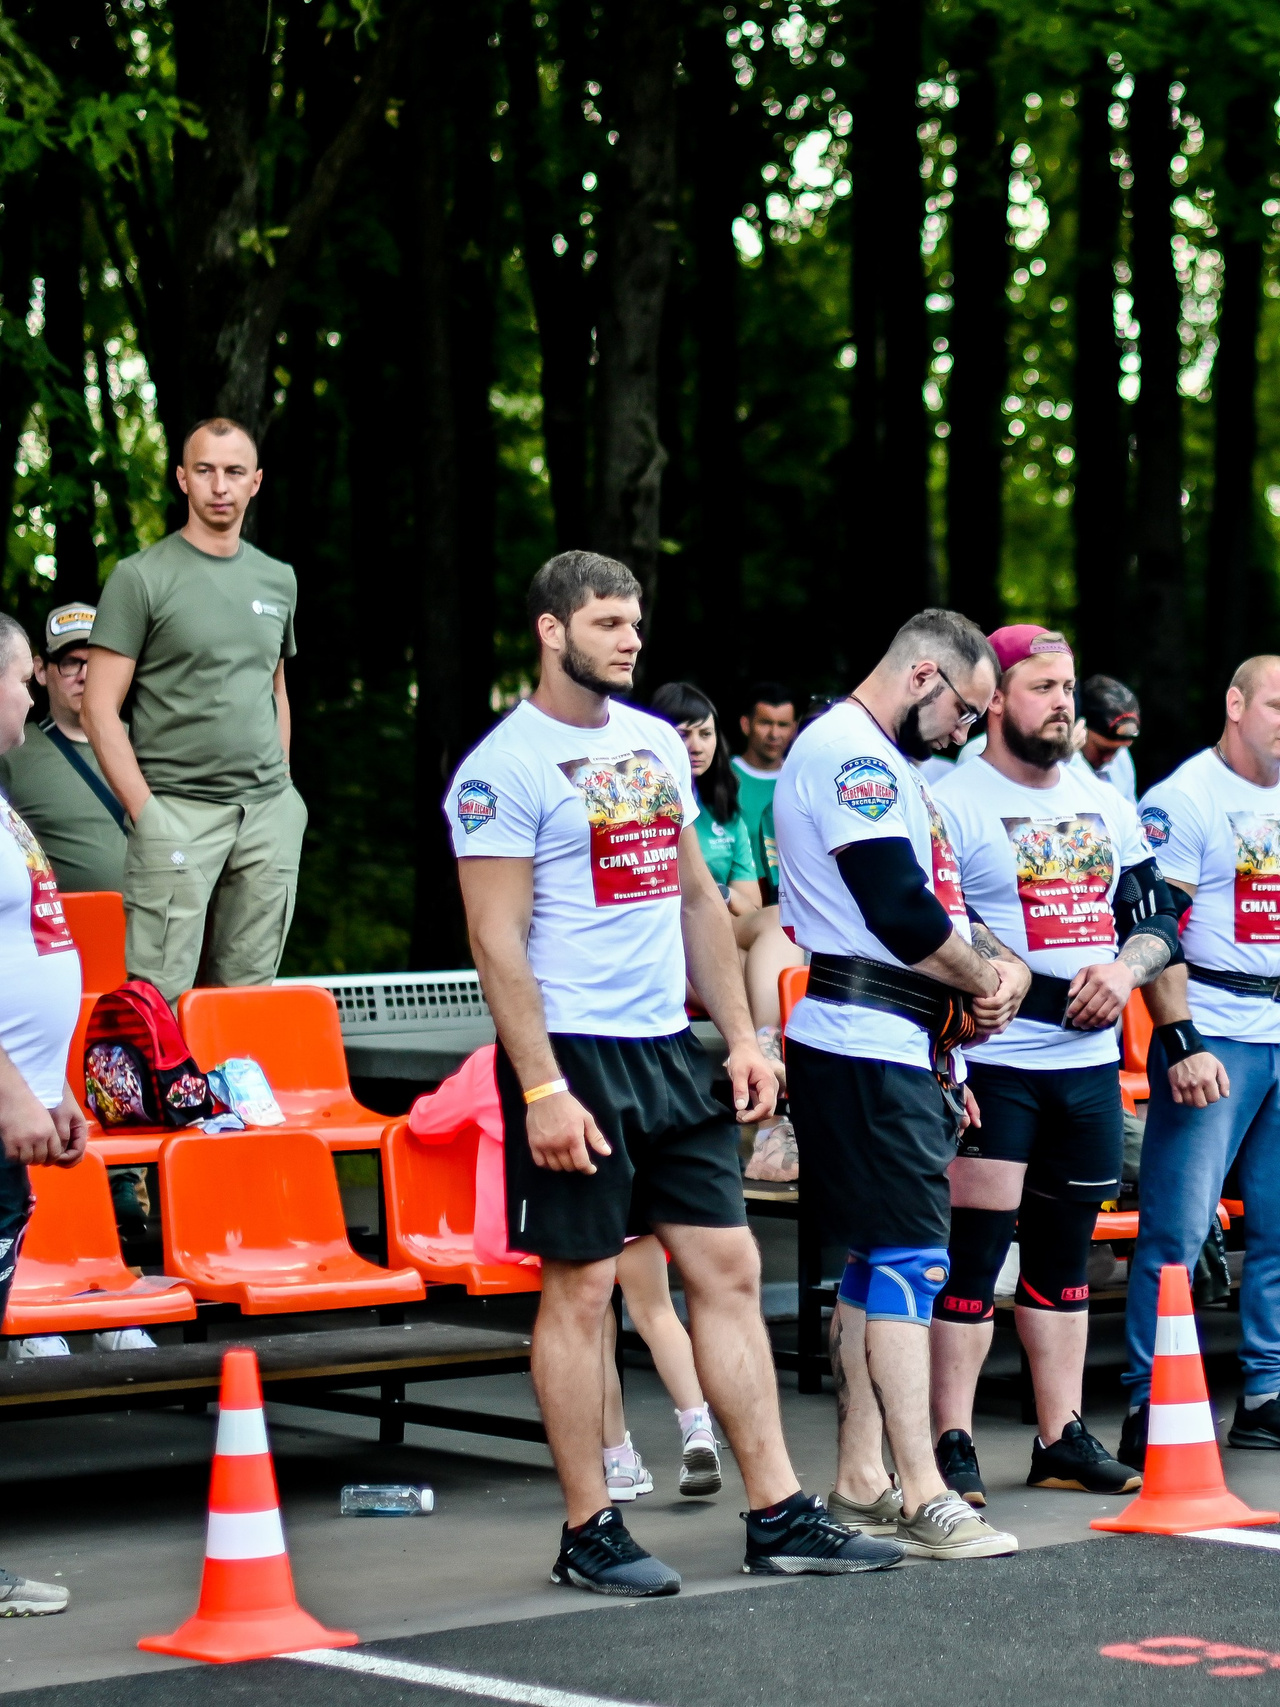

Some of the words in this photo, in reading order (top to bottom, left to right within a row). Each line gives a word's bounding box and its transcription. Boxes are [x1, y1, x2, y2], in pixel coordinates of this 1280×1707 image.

[599, 852, 639, 869] СИЛА
[1029, 903, 1068, 918] СИЛА
[1241, 900, 1277, 913] СИЛА
